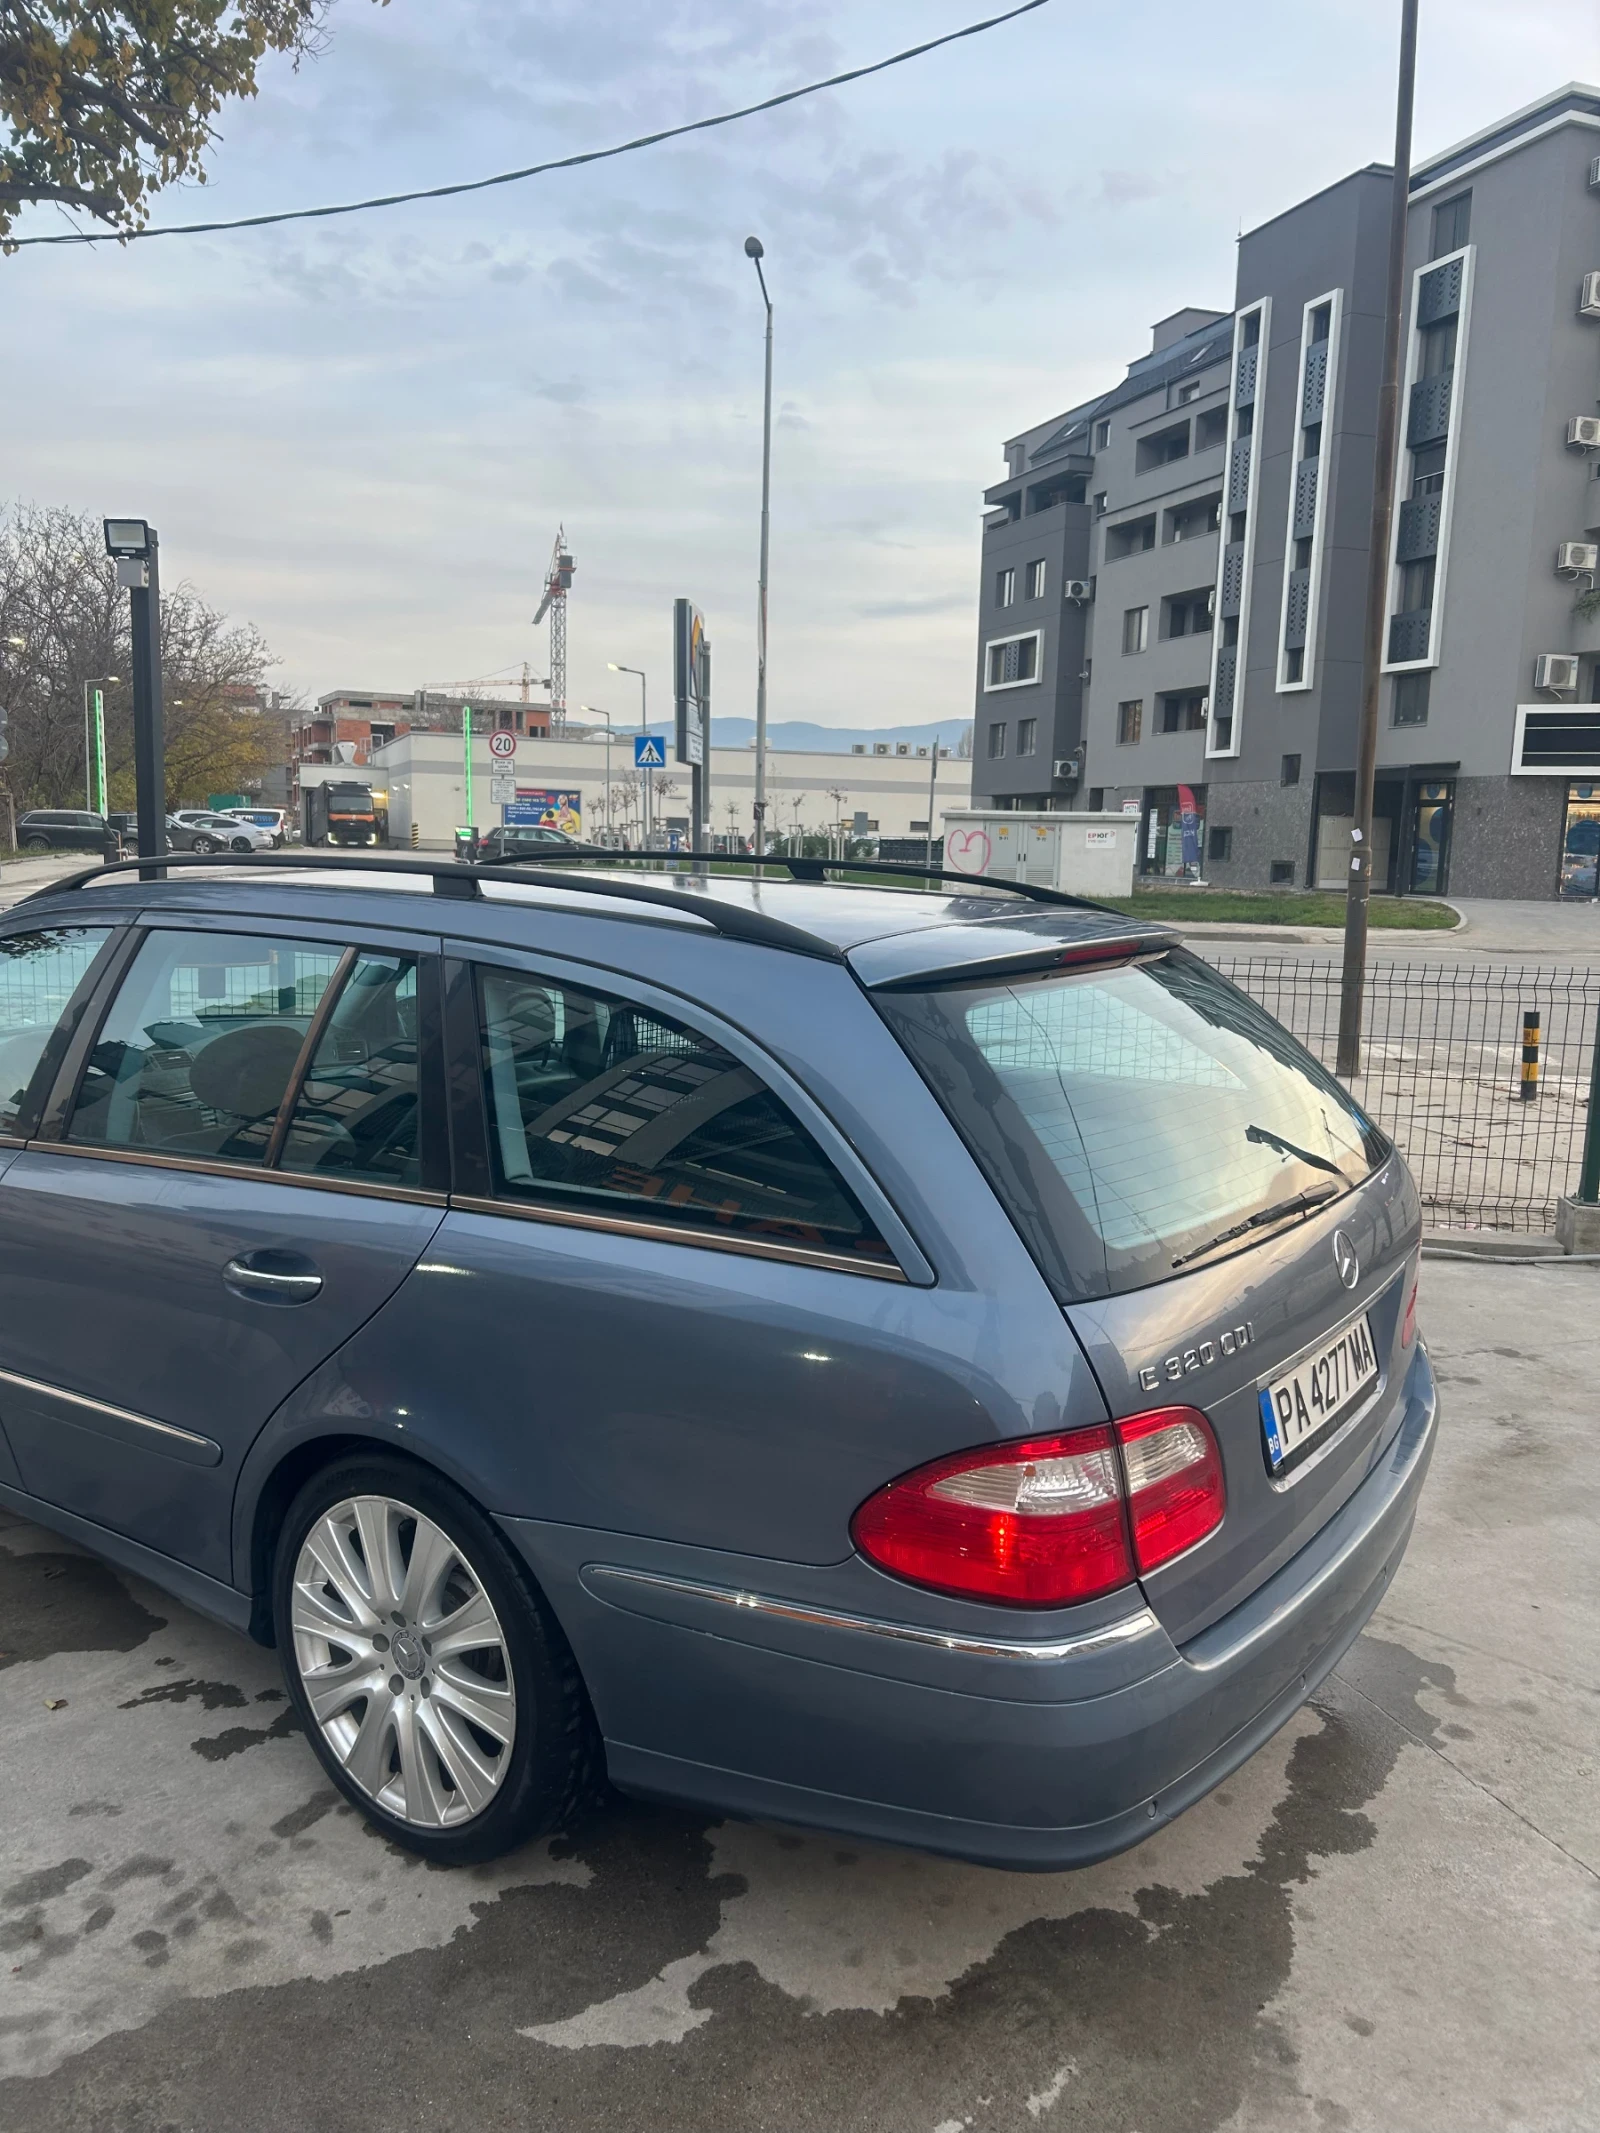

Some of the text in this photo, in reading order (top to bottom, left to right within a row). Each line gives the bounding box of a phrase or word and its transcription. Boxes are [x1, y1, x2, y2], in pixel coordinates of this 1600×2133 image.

[495, 737, 511, 752] 20
[1138, 1321, 1255, 1392] E 320 CDI
[1274, 1375, 1311, 1445] PA
[1311, 1337, 1350, 1416] 4277
[1347, 1322, 1374, 1381] MA
[1268, 1434, 1279, 1454] BG
